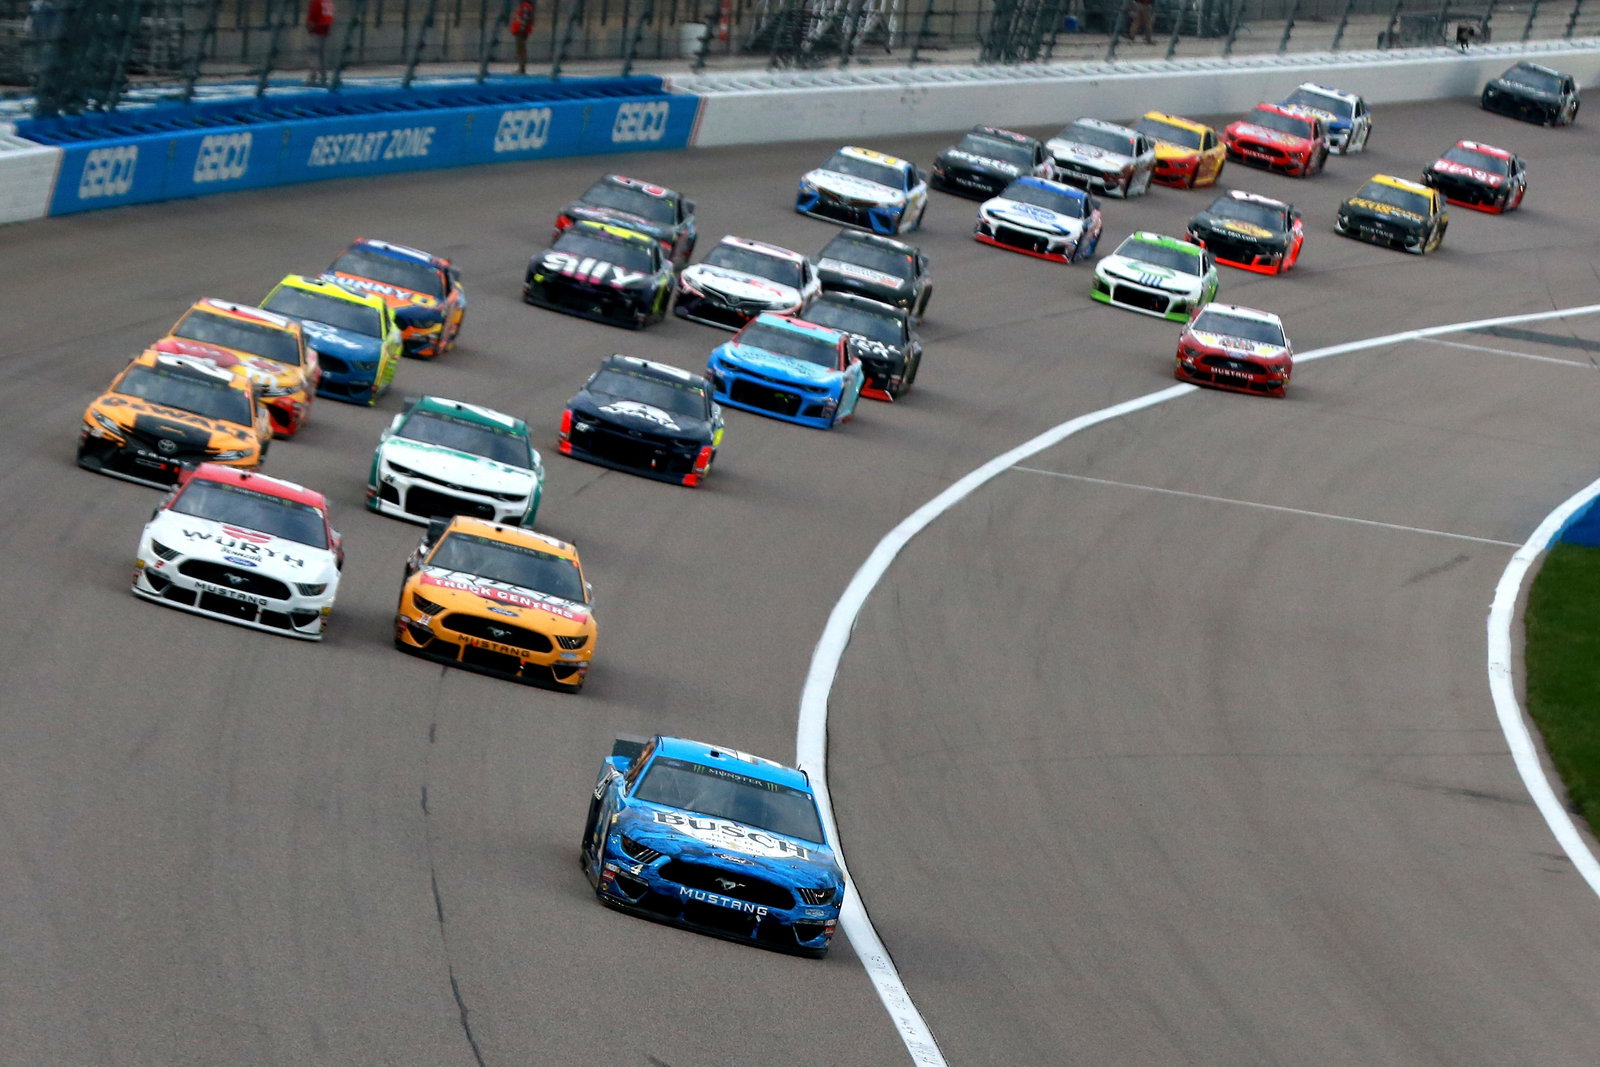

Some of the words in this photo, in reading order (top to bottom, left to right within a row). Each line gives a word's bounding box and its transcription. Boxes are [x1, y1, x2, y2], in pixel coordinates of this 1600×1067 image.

[494, 107, 552, 153] GEICO
[612, 101, 670, 143] GEICO
[193, 131, 252, 183] GEICO
[307, 131, 388, 167] RESTART
[383, 126, 436, 160] ZONE
[78, 144, 139, 199] GEICO
[1210, 366, 1255, 381] MUSTANG
[194, 580, 268, 606] MUSTANG
[434, 578, 491, 597] TRUCK
[497, 590, 574, 619] CENTERS
[457, 632, 531, 659] MUSTANG
[707, 767, 763, 787] MONSTER
[652, 810, 809, 861] BUSCH
[630, 863, 644, 876] 4
[679, 885, 769, 916] MUSTANG
